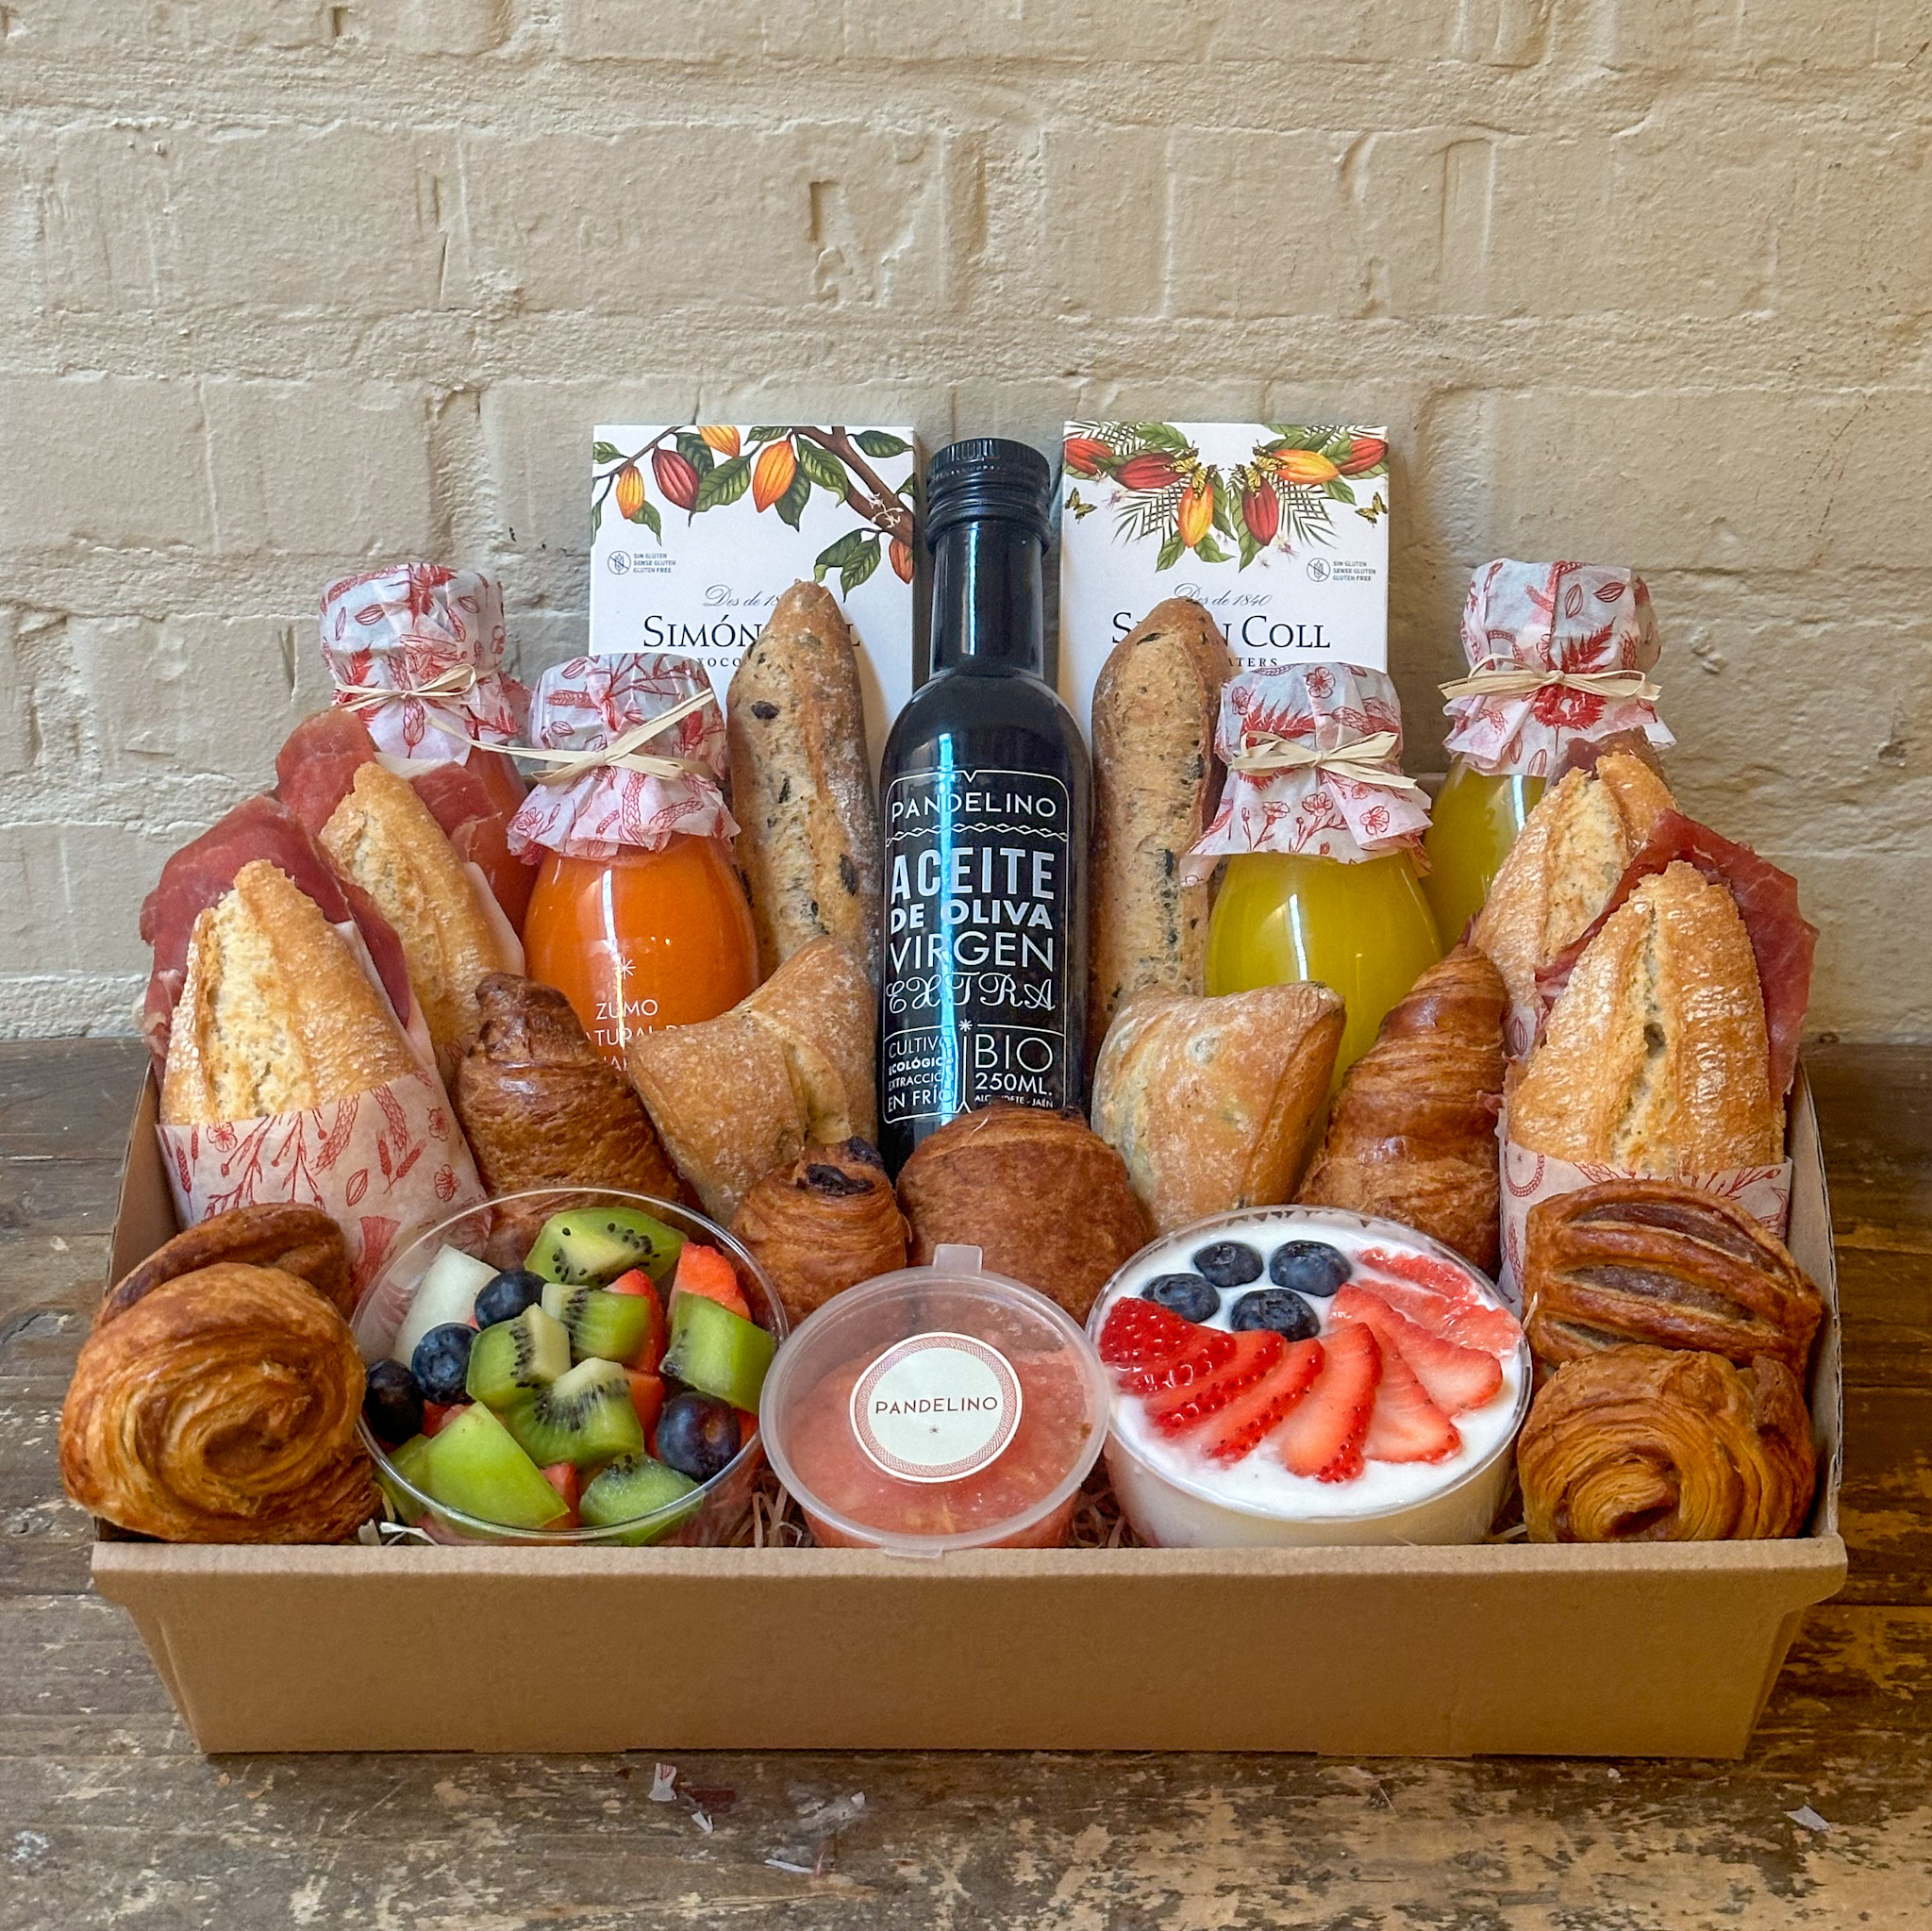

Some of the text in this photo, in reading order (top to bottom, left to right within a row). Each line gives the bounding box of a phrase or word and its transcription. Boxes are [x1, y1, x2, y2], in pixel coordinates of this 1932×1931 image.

[703, 584, 781, 607] Des de 18
[1212, 590, 1232, 606] de
[1233, 593, 1273, 607] 1840
[643, 614, 762, 648] SIMÓN
[1241, 615, 1331, 648] COLL
[891, 792, 1057, 823] PANDELINO
[891, 847, 1055, 905] ACEITE
[891, 899, 1054, 935] DE OLIVA
[890, 931, 1054, 974] VIRGEN
[886, 971, 1056, 1014] EXTRA
[595, 999, 658, 1021] ZUMO
[889, 1035, 954, 1058] CULTIVO
[974, 1033, 1054, 1073] BIO
[889, 1084, 954, 1113] EN FRÍO
[974, 1072, 1053, 1096] 250ML.
[875, 1396, 998, 1415] PANDELINO
